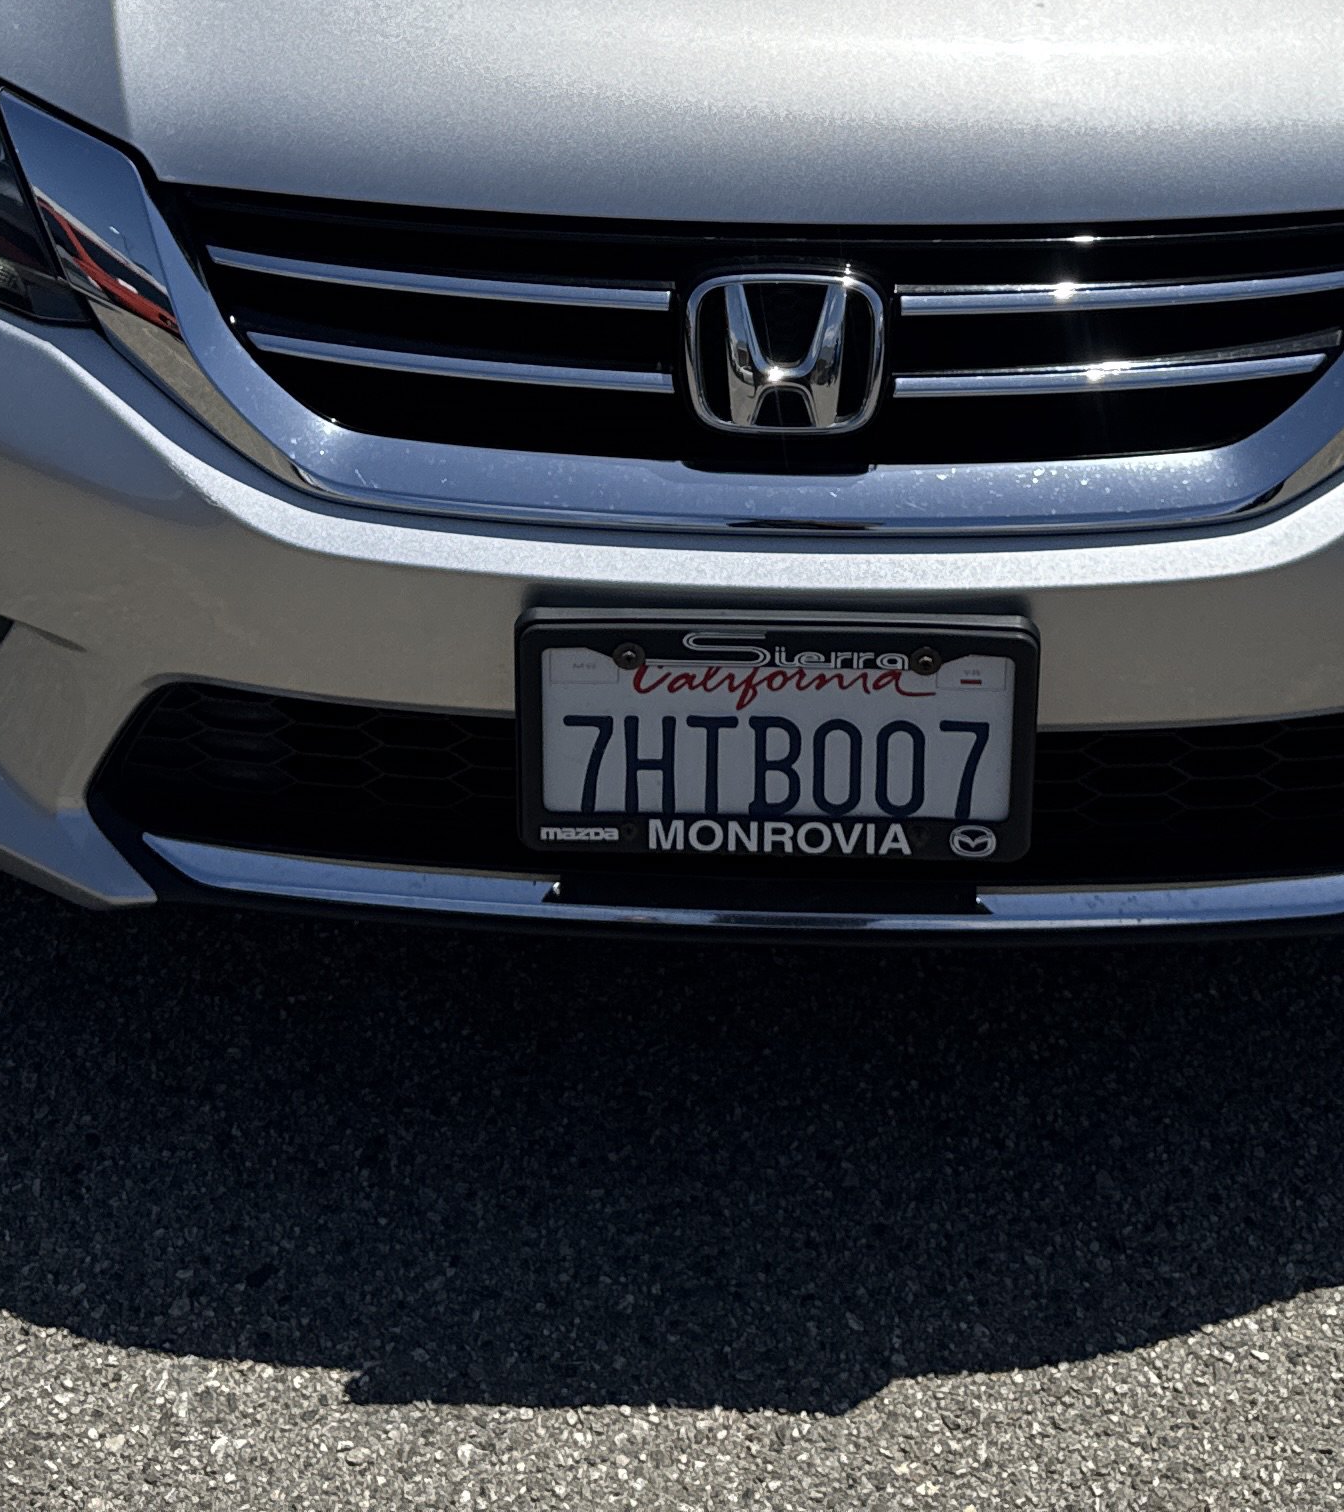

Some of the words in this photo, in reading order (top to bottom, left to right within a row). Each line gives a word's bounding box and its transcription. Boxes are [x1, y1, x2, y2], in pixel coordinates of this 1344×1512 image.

[646, 631, 909, 671] Sierra
[632, 663, 936, 710] California
[562, 714, 990, 820] 7HTB007
[648, 819, 912, 856] MONROVIA
